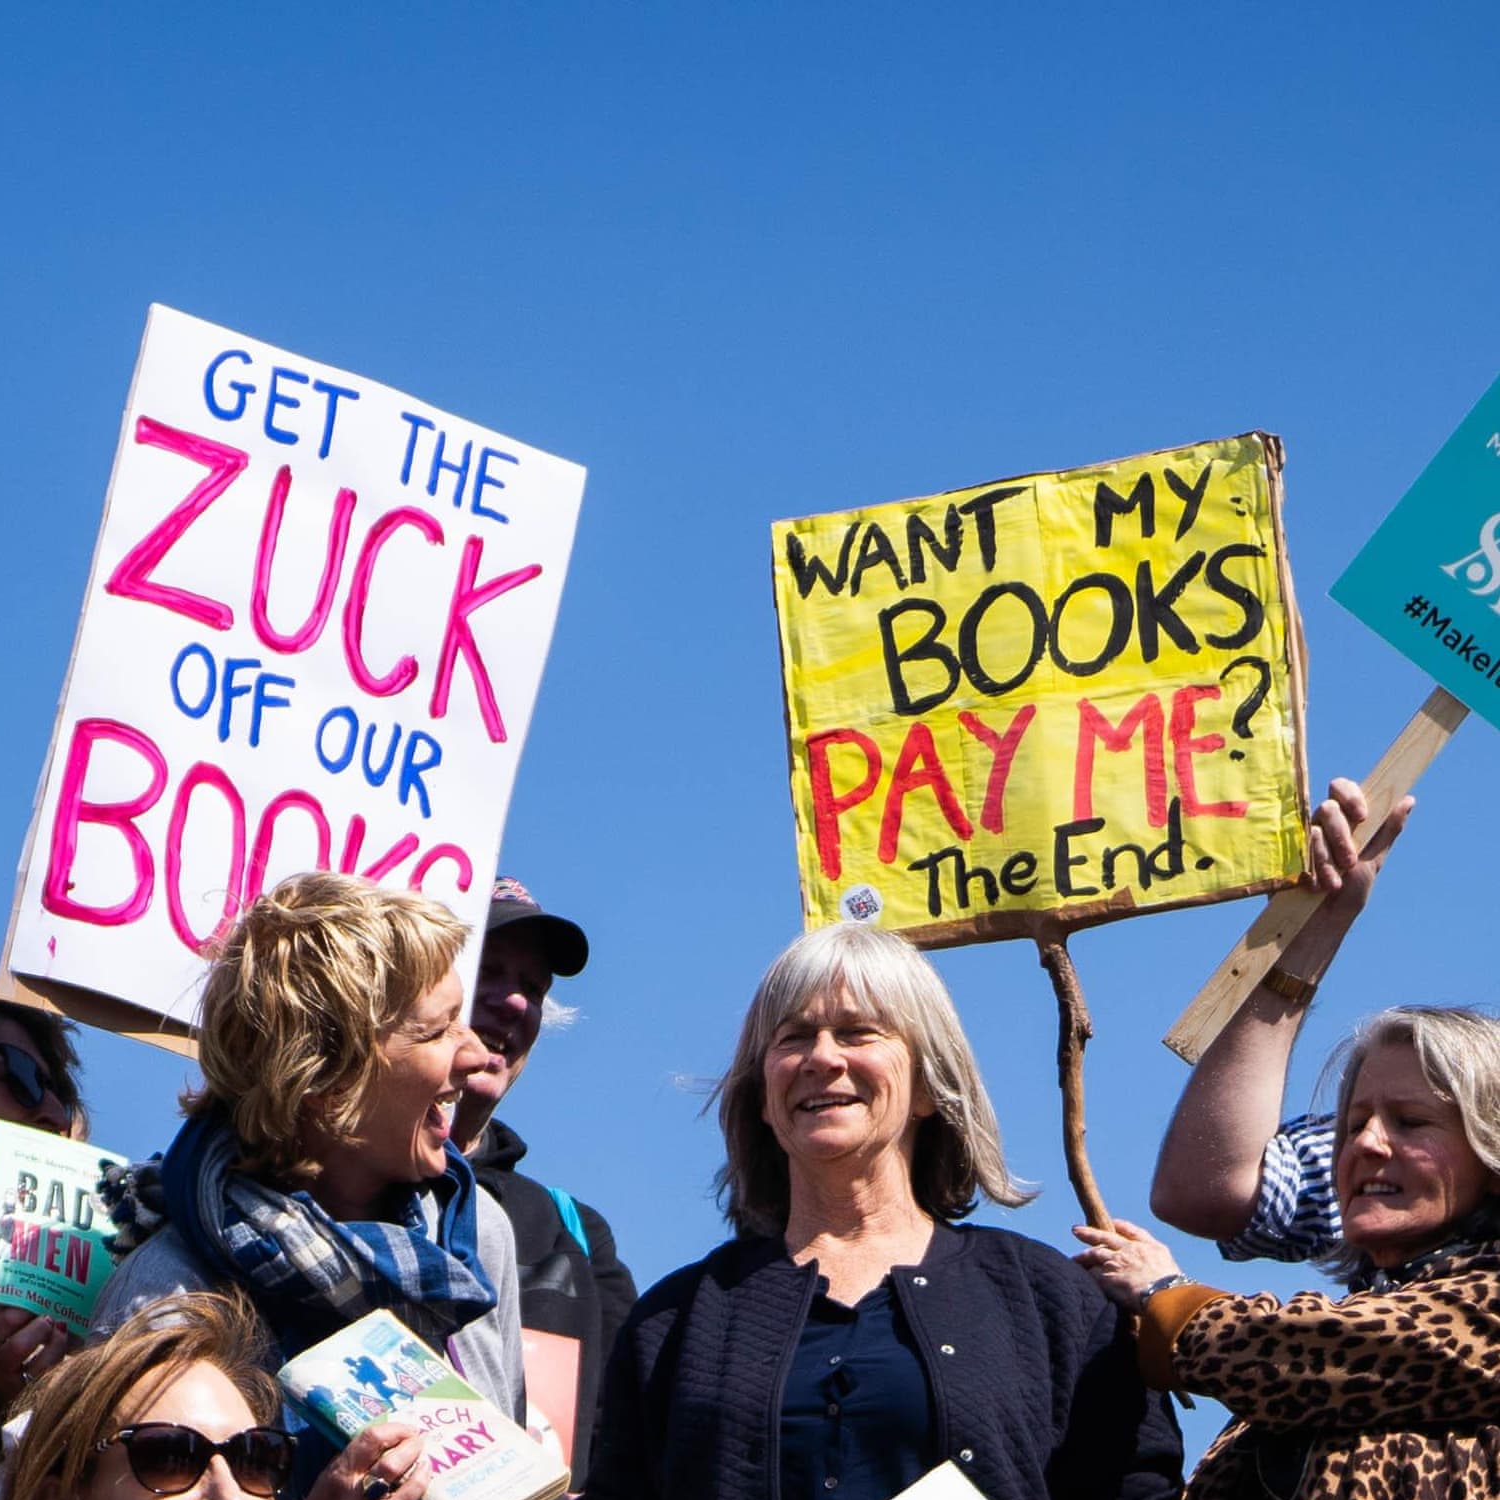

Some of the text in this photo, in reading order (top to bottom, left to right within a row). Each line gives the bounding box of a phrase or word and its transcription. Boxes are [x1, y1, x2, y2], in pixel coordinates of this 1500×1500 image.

[203, 350, 520, 524] GET THE
[104, 415, 543, 744] ZUCK
[786, 458, 1214, 599] WANT MY
[878, 542, 1268, 716] BOOKS
[170, 642, 443, 819] OFF OUR
[806, 703, 1037, 881] PAY
[907, 796, 1215, 917] The End.
[10, 1219, 92, 1286] MEN
[17, 1169, 94, 1231] BAD
